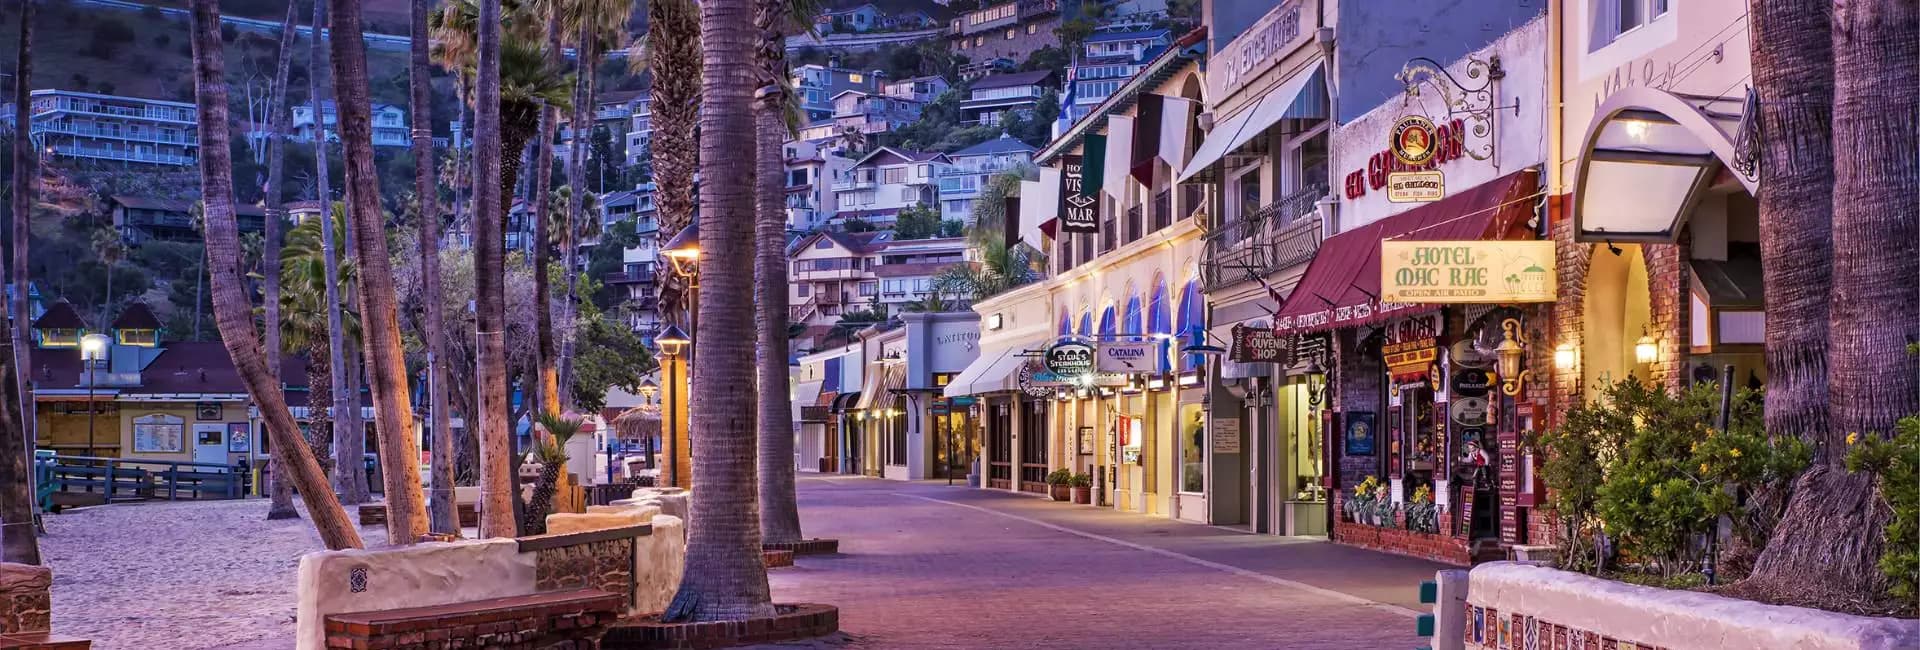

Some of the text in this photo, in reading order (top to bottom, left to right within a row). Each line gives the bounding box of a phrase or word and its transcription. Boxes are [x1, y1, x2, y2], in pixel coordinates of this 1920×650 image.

[1241, 7, 1299, 75] EDGEWATER
[1066, 164, 1083, 172] HO
[1345, 168, 1366, 200] EL
[1393, 183, 1404, 191] EL
[1067, 207, 1094, 221] MAR
[1411, 247, 1475, 265] HOTEL
[1395, 267, 1488, 286] MAC RAE
[1245, 334, 1287, 349] SOUVENIR
[1108, 347, 1145, 357] CATALINA
[1252, 348, 1277, 360] SHOP
